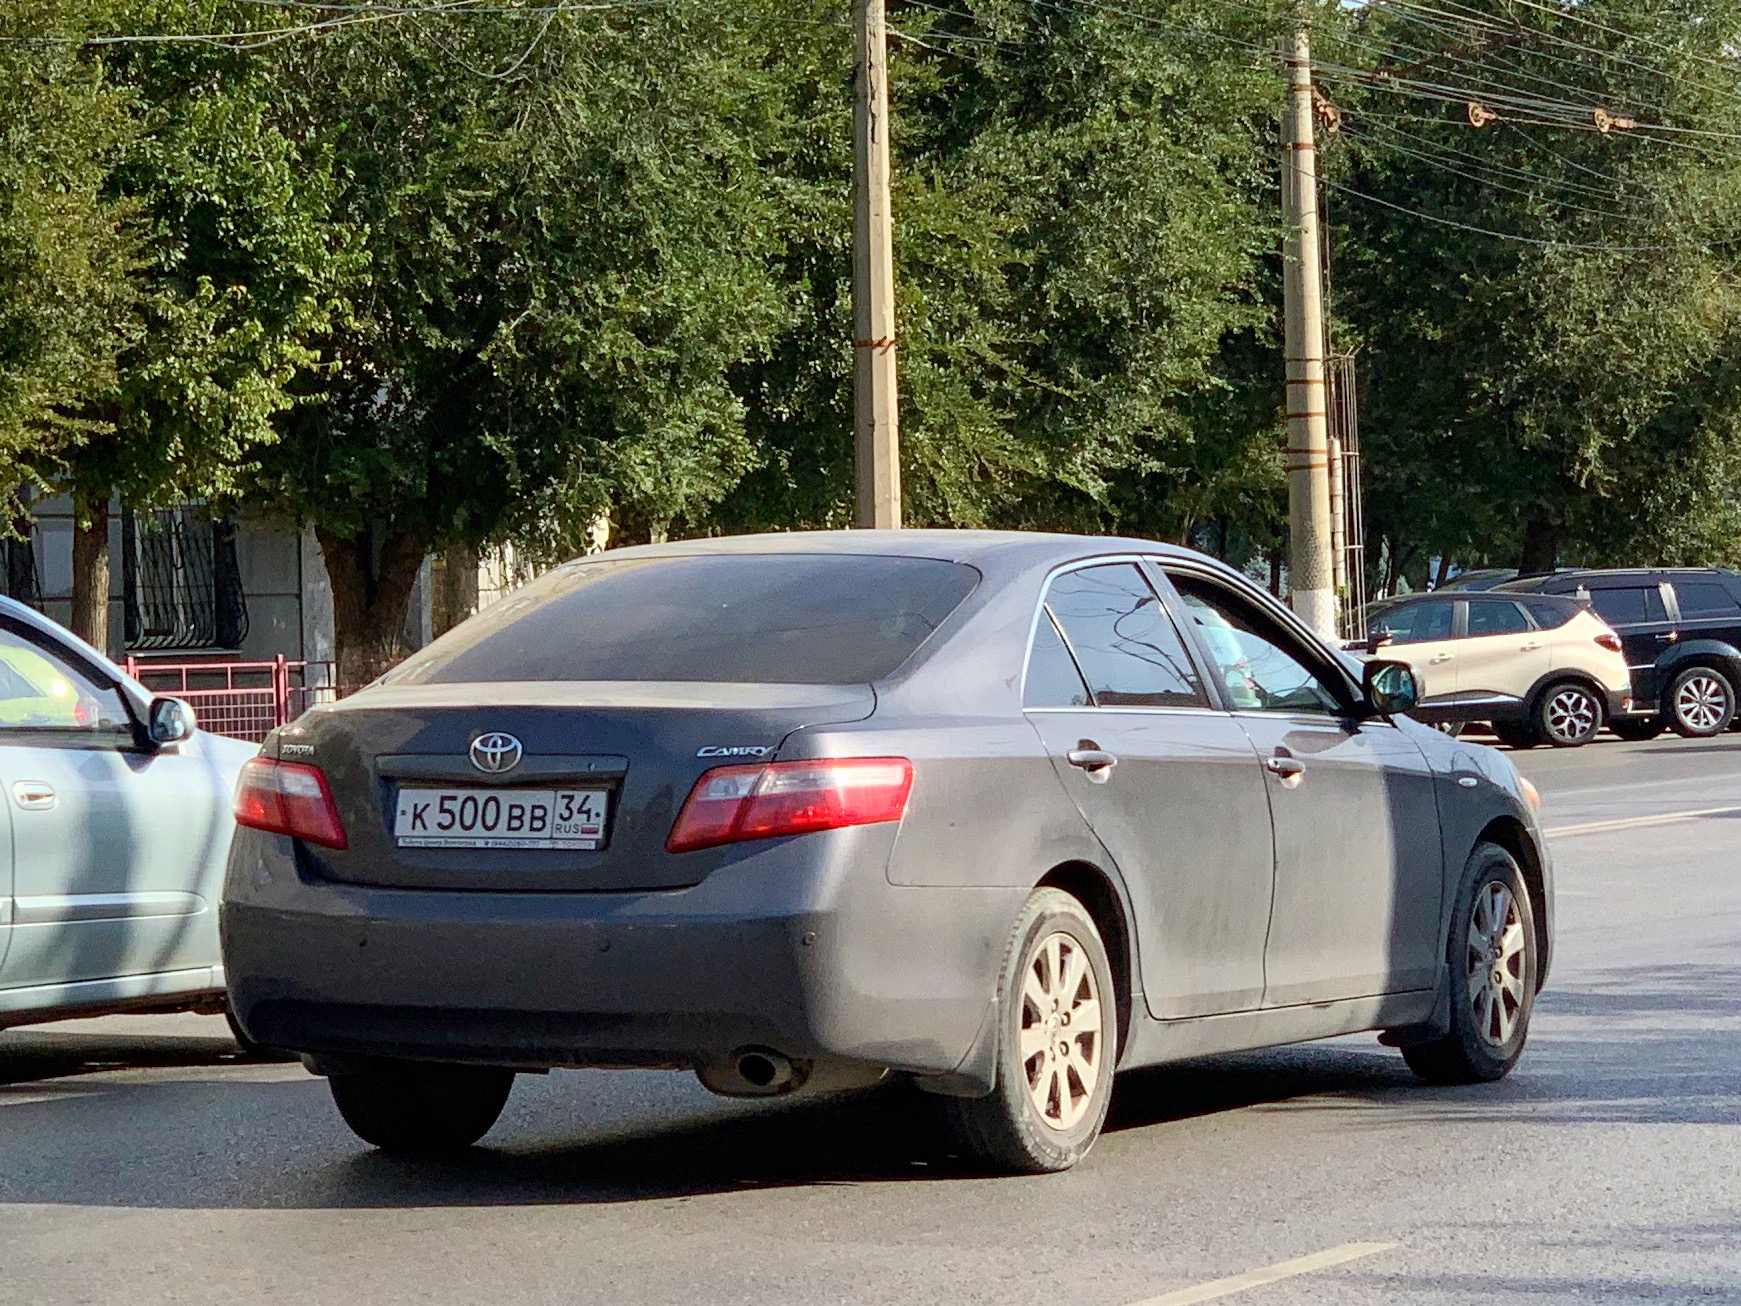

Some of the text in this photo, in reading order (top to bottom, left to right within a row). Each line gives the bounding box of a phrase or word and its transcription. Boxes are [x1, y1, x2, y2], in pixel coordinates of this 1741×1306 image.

[696, 745, 776, 757] CAMRY
[559, 794, 592, 822] 34
[555, 823, 580, 834] RUS
